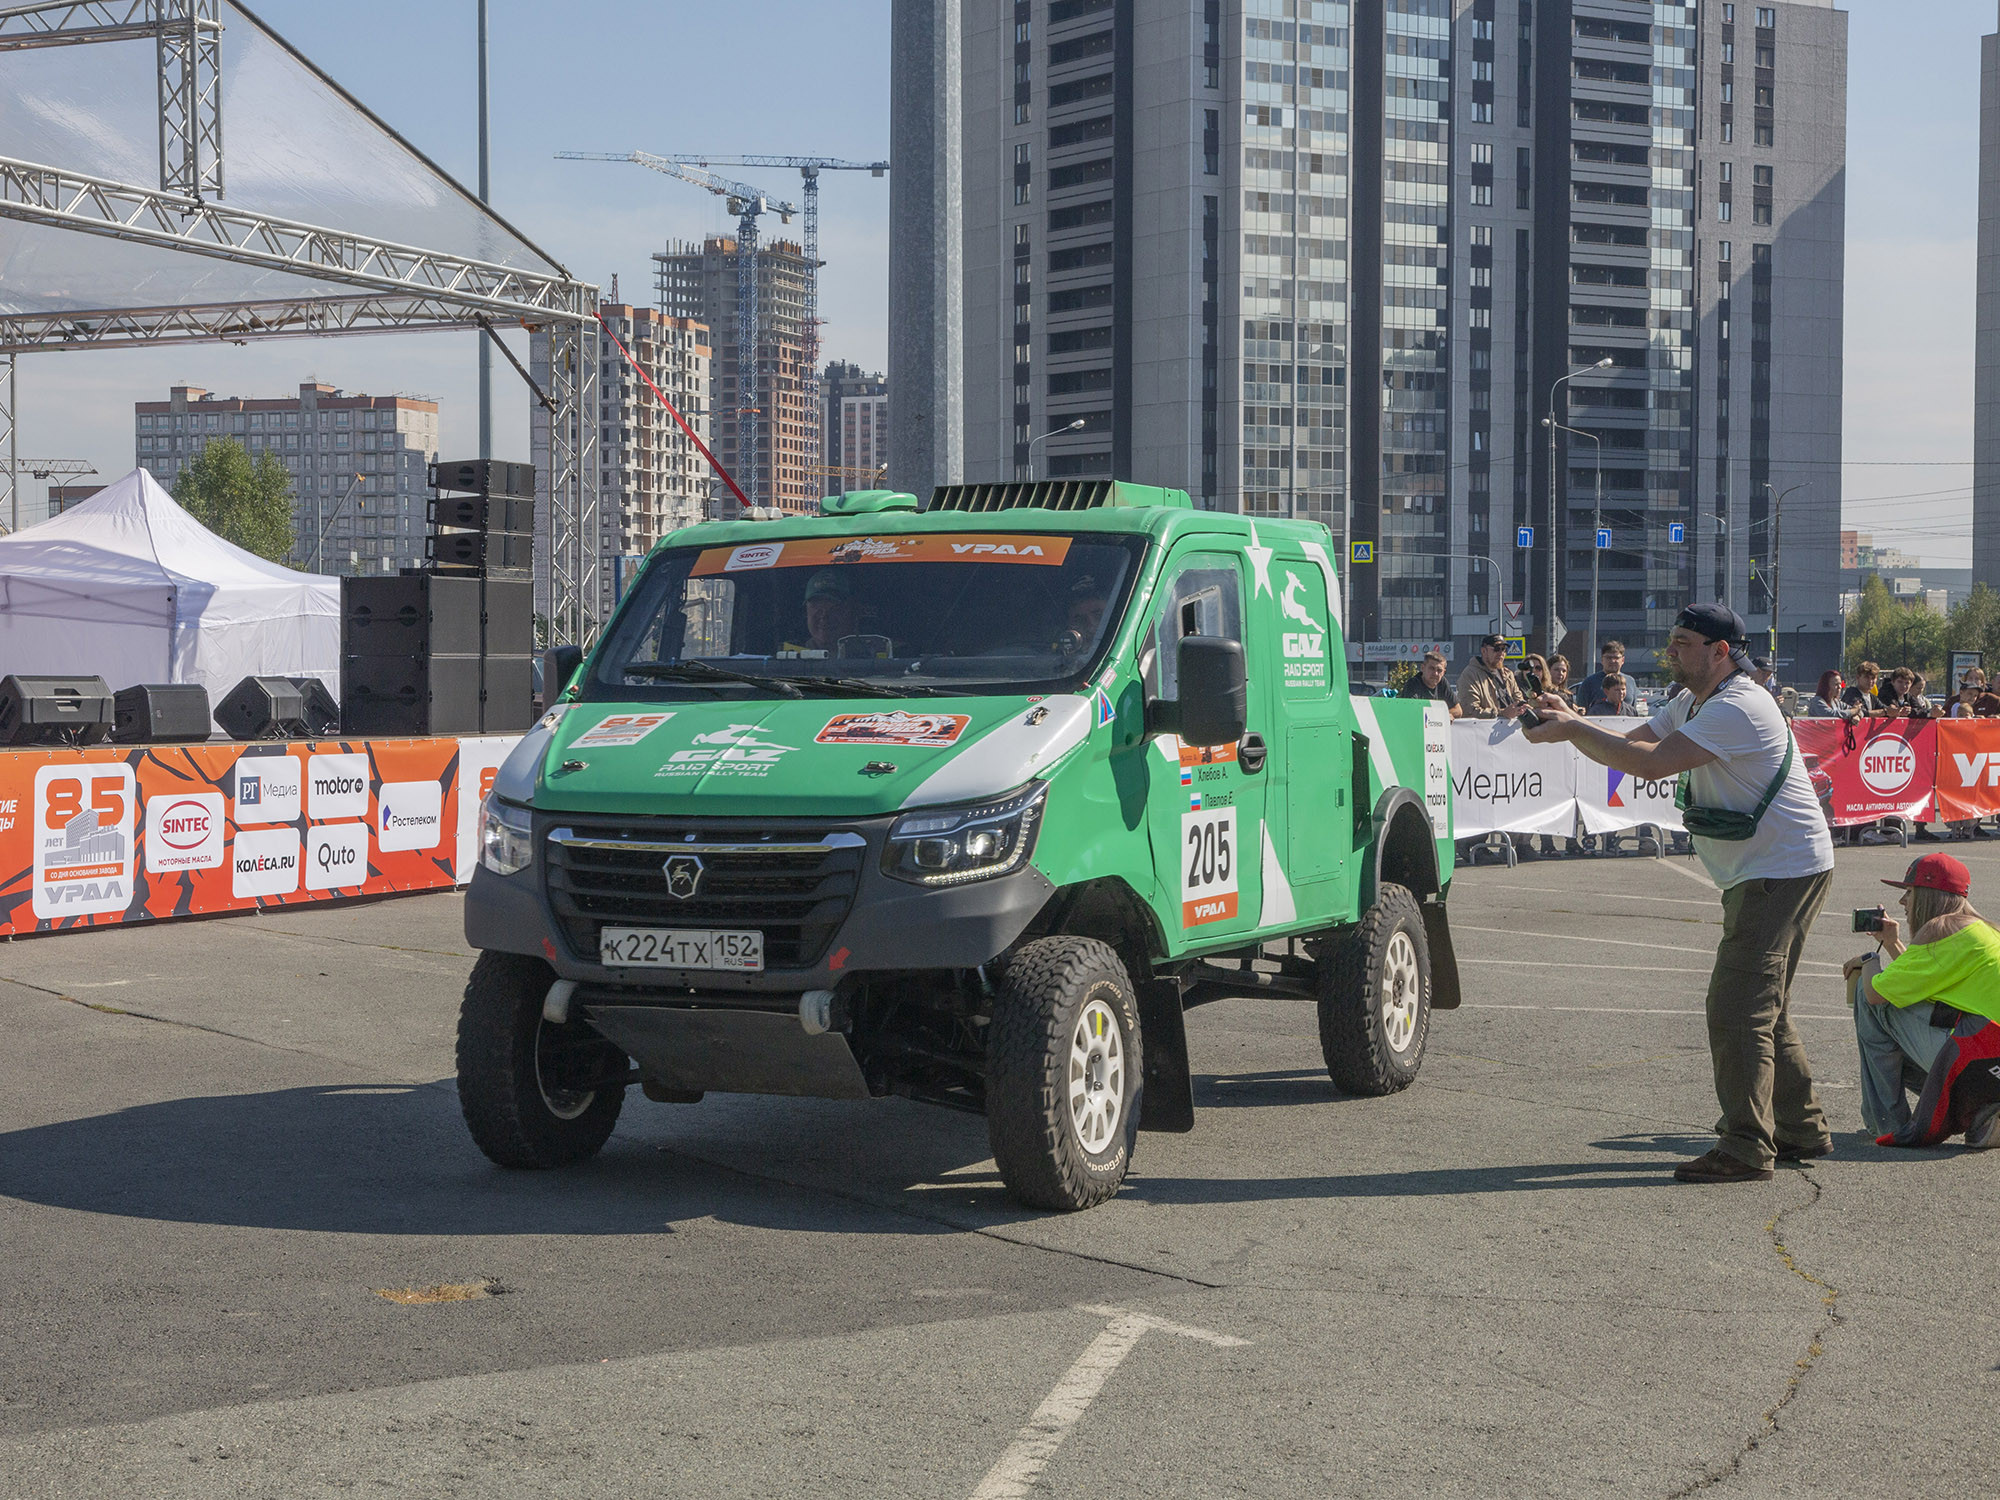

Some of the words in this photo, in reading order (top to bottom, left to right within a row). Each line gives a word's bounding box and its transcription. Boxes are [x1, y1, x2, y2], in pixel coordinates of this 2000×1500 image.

[740, 551, 772, 559] SINTEC
[950, 543, 1044, 556] УРАЛ
[1282, 632, 1324, 658] GAZ
[1284, 663, 1301, 677] RAID
[1302, 663, 1325, 677] SPORT
[599, 716, 665, 729] 85
[668, 749, 788, 762] GAZ
[658, 763, 707, 772] RAID
[711, 761, 775, 771] SPORT
[1864, 755, 1911, 774] SINTEC
[1197, 766, 1221, 782] Хлебов
[242, 782, 258, 800] РГ
[262, 783, 298, 799] Медиа
[0, 799, 18, 814] ИЕ
[45, 775, 126, 830] 85
[1846, 803, 1864, 812] МАСЛА
[1865, 802, 1895, 811] АНТИФРИЗЫ
[162, 816, 209, 834] SINTEC
[392, 815, 437, 827] Ростелеком
[44, 837, 64, 848] лет
[158, 857, 191, 867] МОТОРНЫЕ
[191, 855, 212, 864] МАСЛА
[318, 843, 356, 873] Quto
[1188, 820, 1231, 888] 205
[50, 871, 58, 879] СО
[58, 871, 68, 880] ДНЯ
[69, 868, 99, 878] ОСНОВАНИЯ
[99, 866, 117, 875] ЗАВОДА
[44, 880, 124, 905] УРАЛ
[1194, 901, 1226, 919] УРАЛ
[715, 935, 754, 956] 152
[723, 957, 744, 967] RUS
